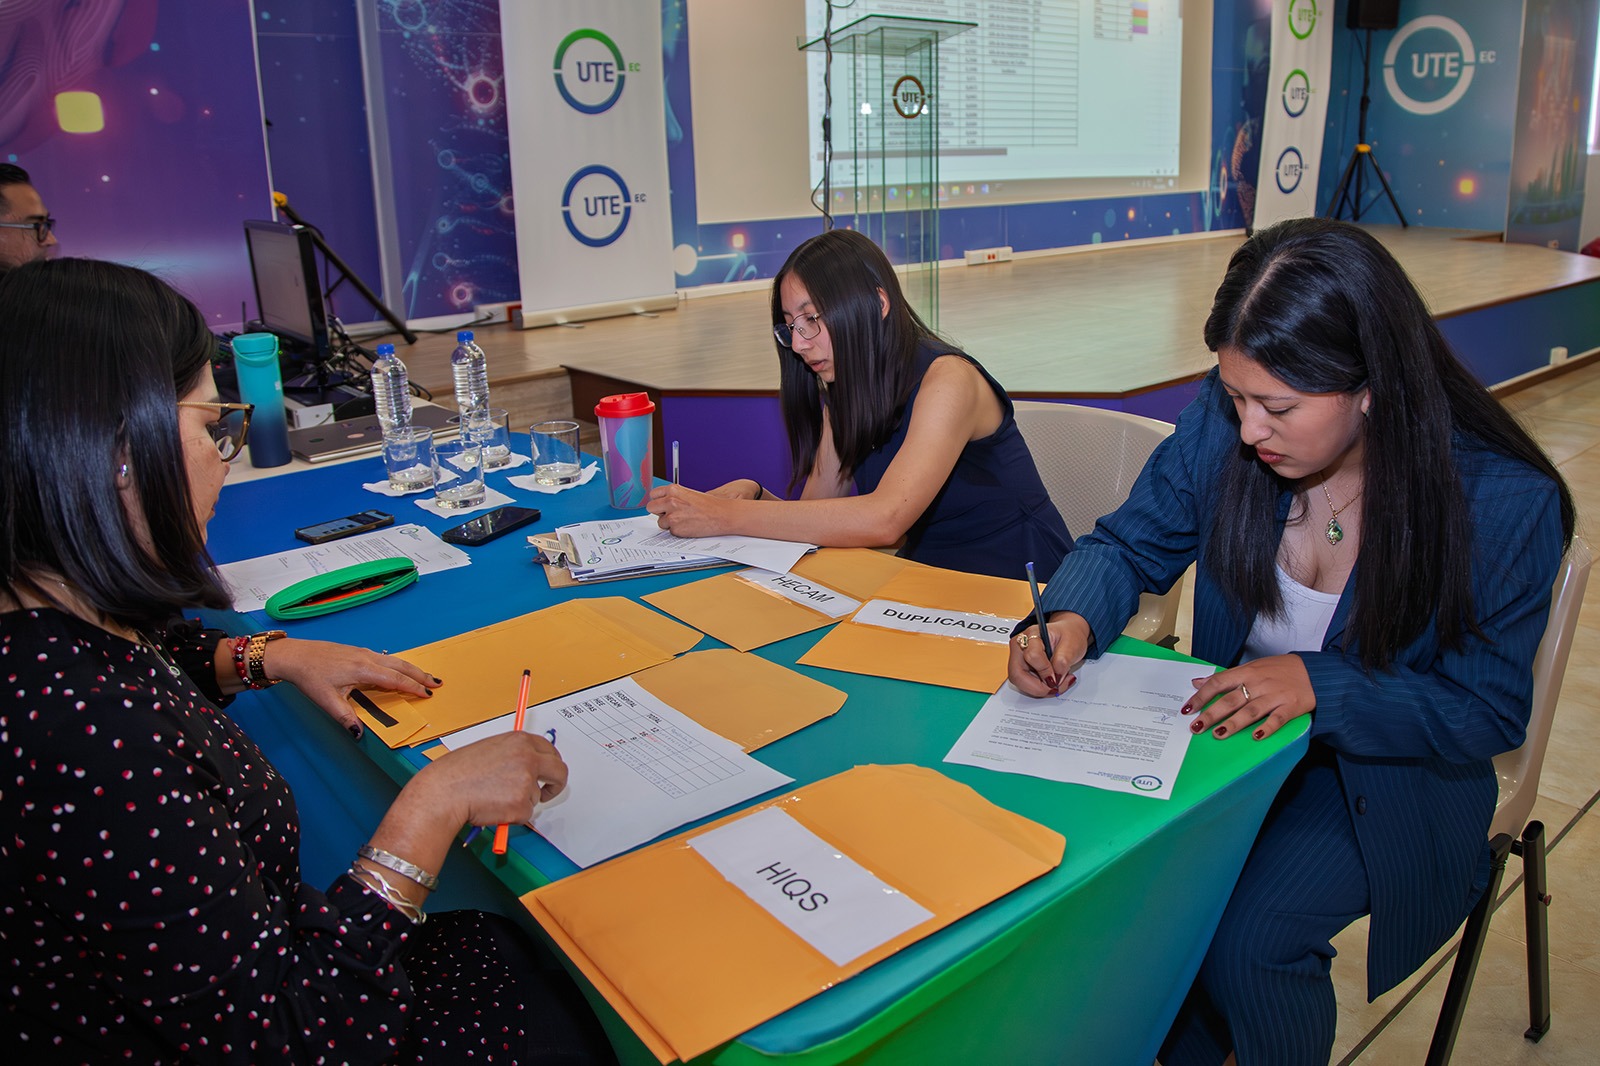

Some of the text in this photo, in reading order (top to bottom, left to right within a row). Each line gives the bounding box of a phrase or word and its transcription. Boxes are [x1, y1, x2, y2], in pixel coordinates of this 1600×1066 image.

[576, 61, 641, 83] UTE EC
[1412, 51, 1496, 78] UTE EC
[902, 92, 920, 103] UTE
[1291, 87, 1307, 100] UTE
[1284, 164, 1299, 176] UTE
[584, 194, 647, 217] UTE EC
[771, 575, 836, 604] HECAM
[882, 608, 1011, 635] DUPLICADOS
[604, 694, 622, 708] HECAM
[615, 691, 662, 724] HOSPITAL TOTAL
[756, 861, 829, 912] HIQS
